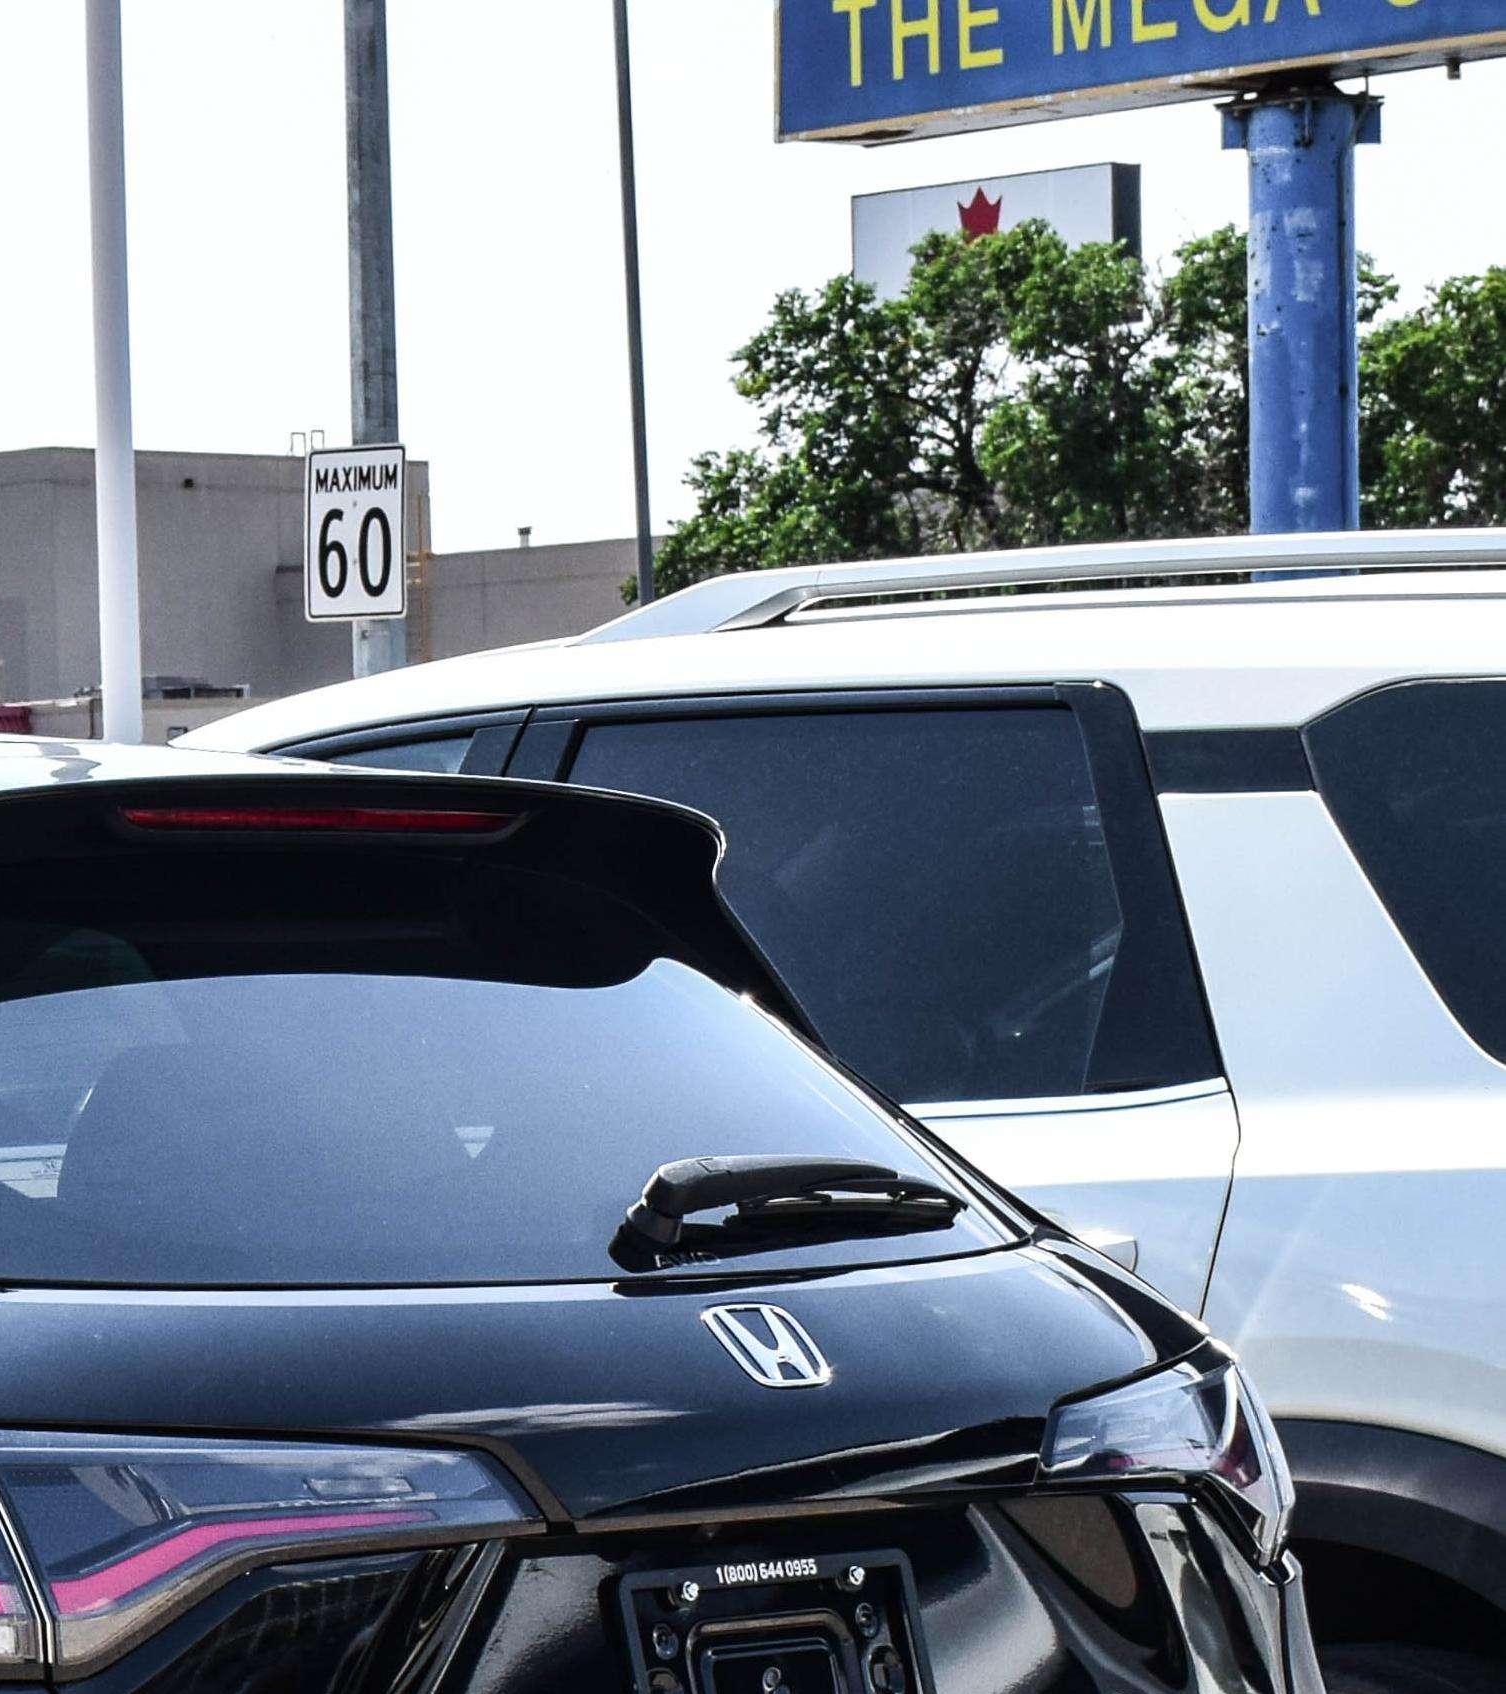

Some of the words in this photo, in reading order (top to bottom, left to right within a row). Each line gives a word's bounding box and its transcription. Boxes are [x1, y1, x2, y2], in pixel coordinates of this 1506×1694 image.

[832, 0, 1003, 87] THE
[315, 464, 398, 494] MAXIMUM
[319, 507, 392, 598] 60
[716, 1564, 758, 1584] 1(800)
[759, 1561, 784, 1579] 644
[784, 1558, 818, 1577] 0955
